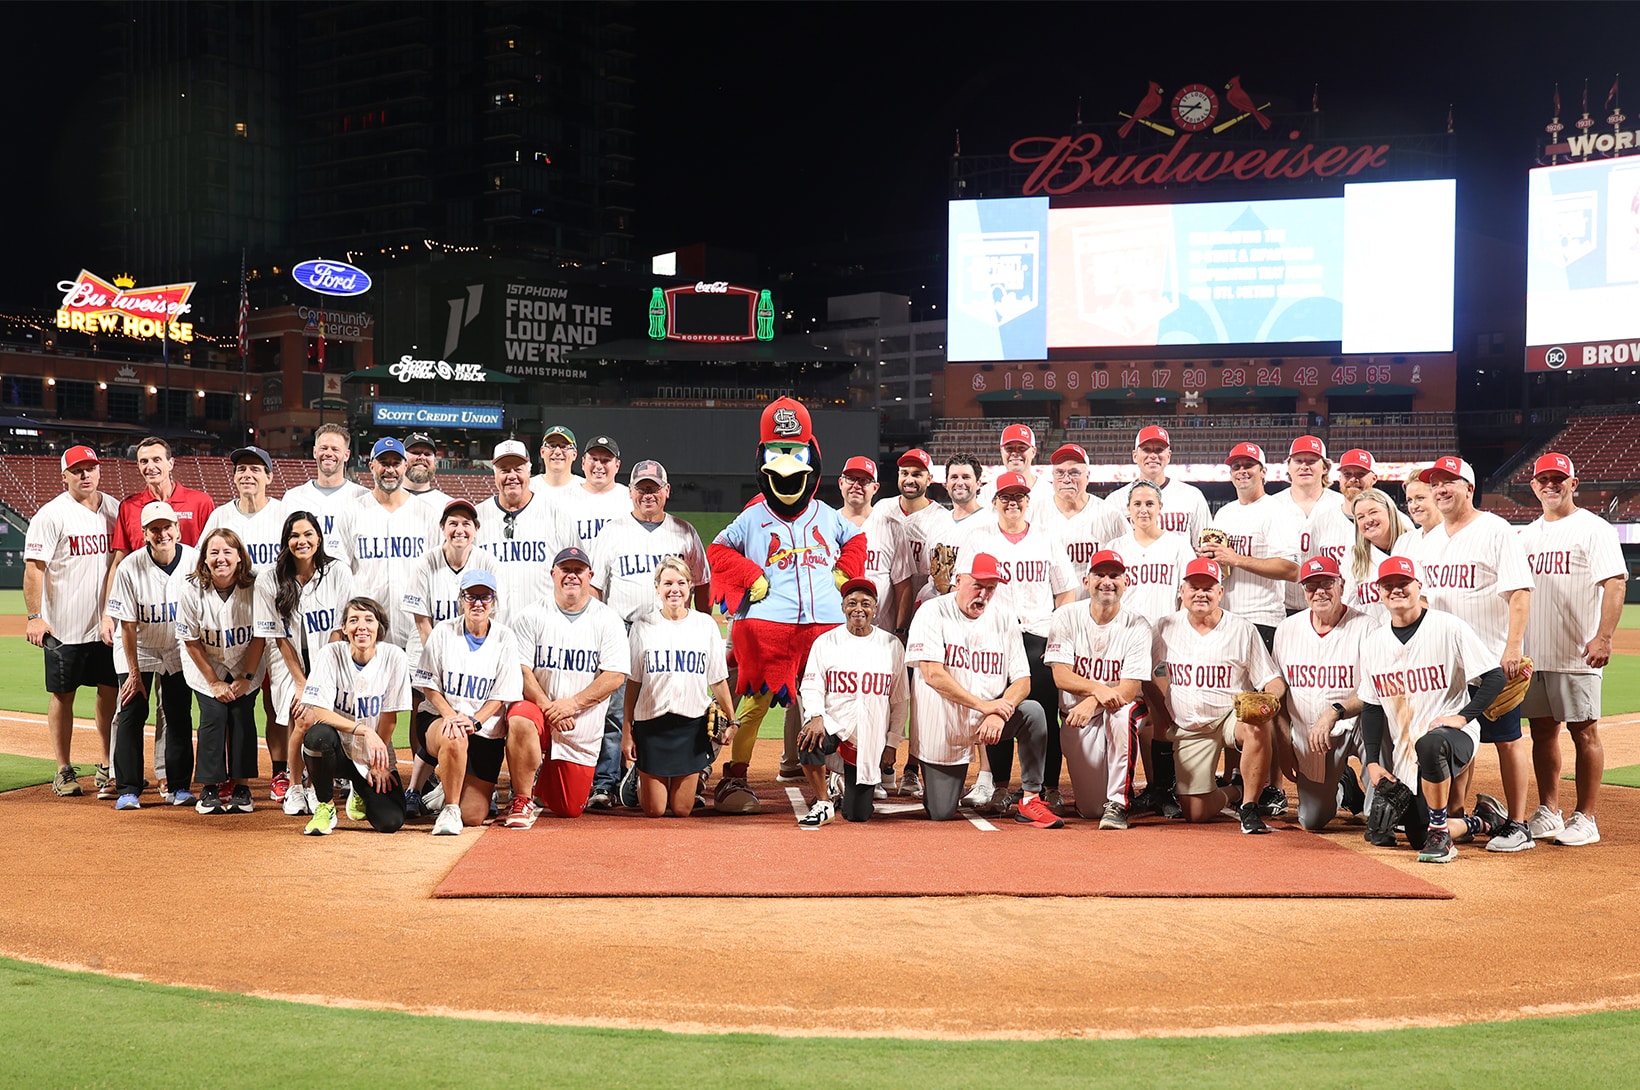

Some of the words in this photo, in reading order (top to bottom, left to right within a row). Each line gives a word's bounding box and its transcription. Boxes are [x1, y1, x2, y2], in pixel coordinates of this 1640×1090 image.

[1009, 131, 1390, 195] Budweiser
[309, 264, 356, 290] Ford
[56, 280, 192, 315] Budweiser
[298, 306, 371, 328] Community
[506, 298, 566, 322] FROM
[572, 304, 612, 326] THE
[56, 309, 118, 333] BREW
[123, 315, 193, 342] HOUSE
[505, 319, 546, 341] LOU
[552, 323, 597, 345] AND
[455, 363, 482, 374] MVP
[1549, 352, 1564, 362] BC
[454, 372, 487, 381] DECK
[505, 365, 587, 379] #IAM1STPHORM
[1004, 372, 1011, 390] 1
[1022, 371, 1034, 390] 2
[1044, 371, 1056, 390] 6
[1067, 370, 1079, 389] 9
[1091, 370, 1109, 389] 10
[1121, 370, 1140, 388] 14
[1152, 369, 1171, 388] 17
[1183, 368, 1206, 387] 20
[1222, 368, 1245, 387] 23
[1257, 367, 1281, 386] 24
[1294, 367, 1318, 386] 42
[1332, 366, 1357, 384] 45
[1366, 365, 1391, 383] 85
[377, 408, 418, 420] SCOTT
[416, 409, 459, 422] CREDIT
[461, 412, 499, 424] UNION
[68, 533, 115, 556] MISSOU
[247, 543, 280, 564] NOIS
[358, 536, 424, 560] ILLINOIS
[619, 553, 684, 577] ILLIN
[800, 548, 829, 569] Louis
[1528, 550, 1571, 575] SOURI
[1000, 560, 1047, 582] SOURI
[1125, 563, 1175, 587] SSOURI
[137, 601, 178, 623] ILLIN
[826, 670, 892, 696] MISSOUR
[1167, 663, 1232, 689] MISSOURI
[1287, 664, 1354, 689] MISSOURI
[1372, 664, 1448, 698] MISSOURI
